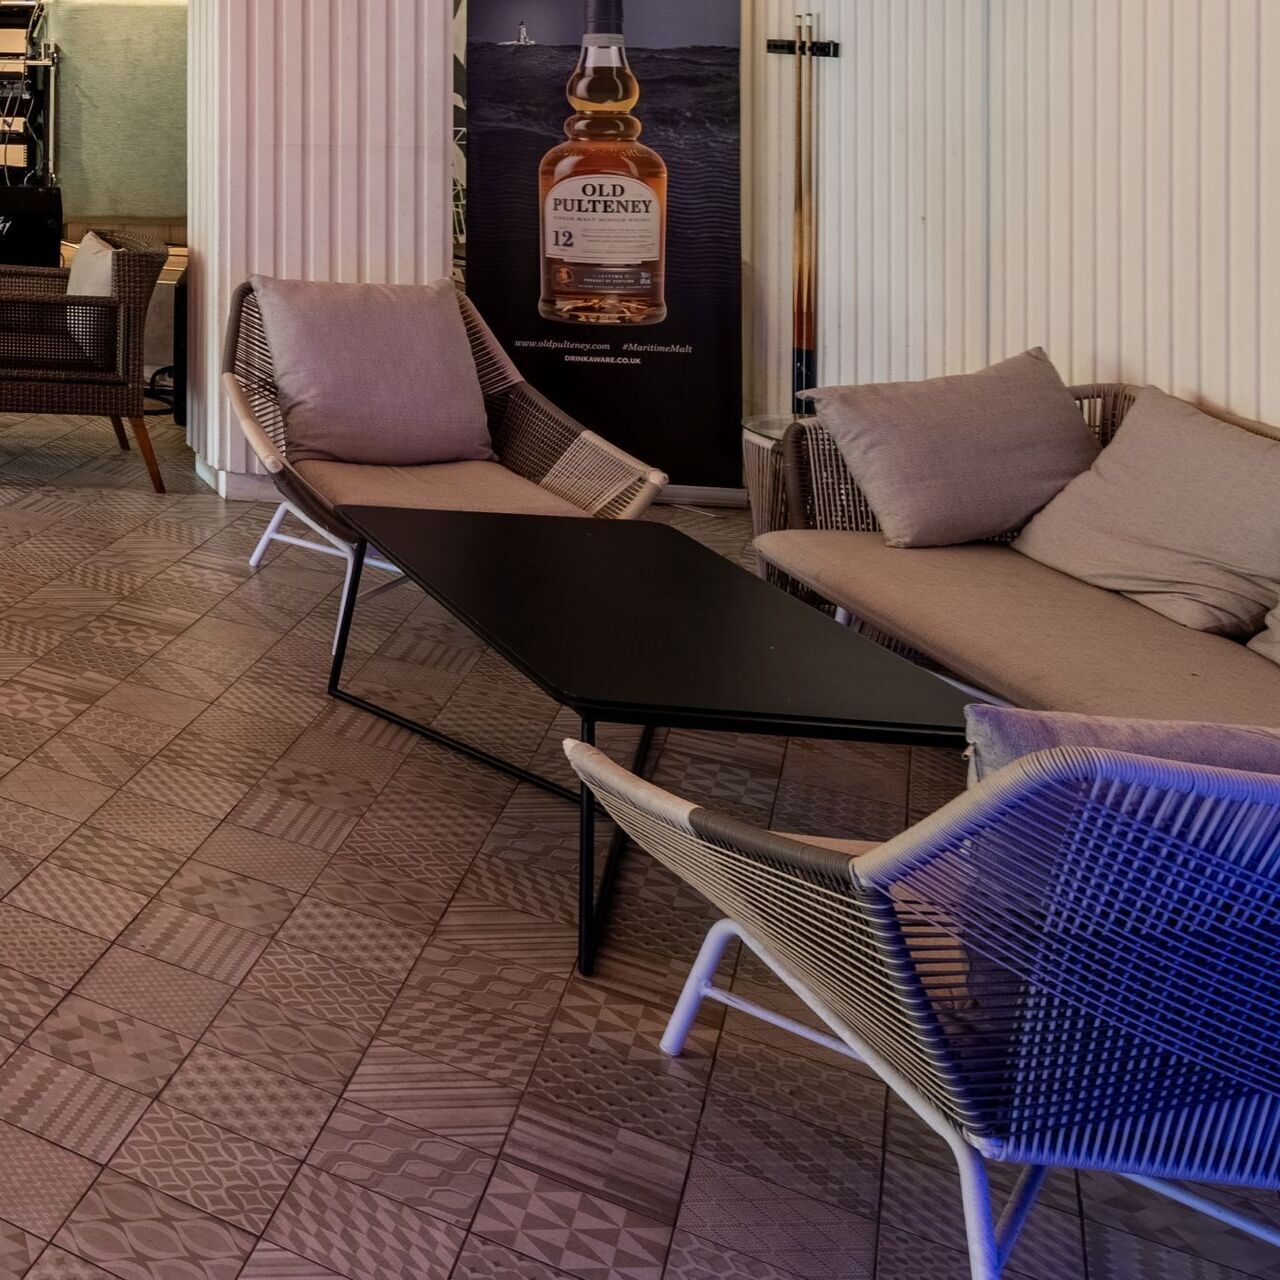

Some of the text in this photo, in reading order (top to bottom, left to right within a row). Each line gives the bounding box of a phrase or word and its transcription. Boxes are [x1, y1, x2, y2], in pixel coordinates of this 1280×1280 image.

[581, 183, 625, 197] OLD
[552, 198, 652, 213] PULTENEY
[552, 230, 574, 247] 12
[515, 339, 692, 353] www.oldpulteney.com #MaritimeMalt
[564, 355, 641, 365] DRINKAWARE.CO.UK
